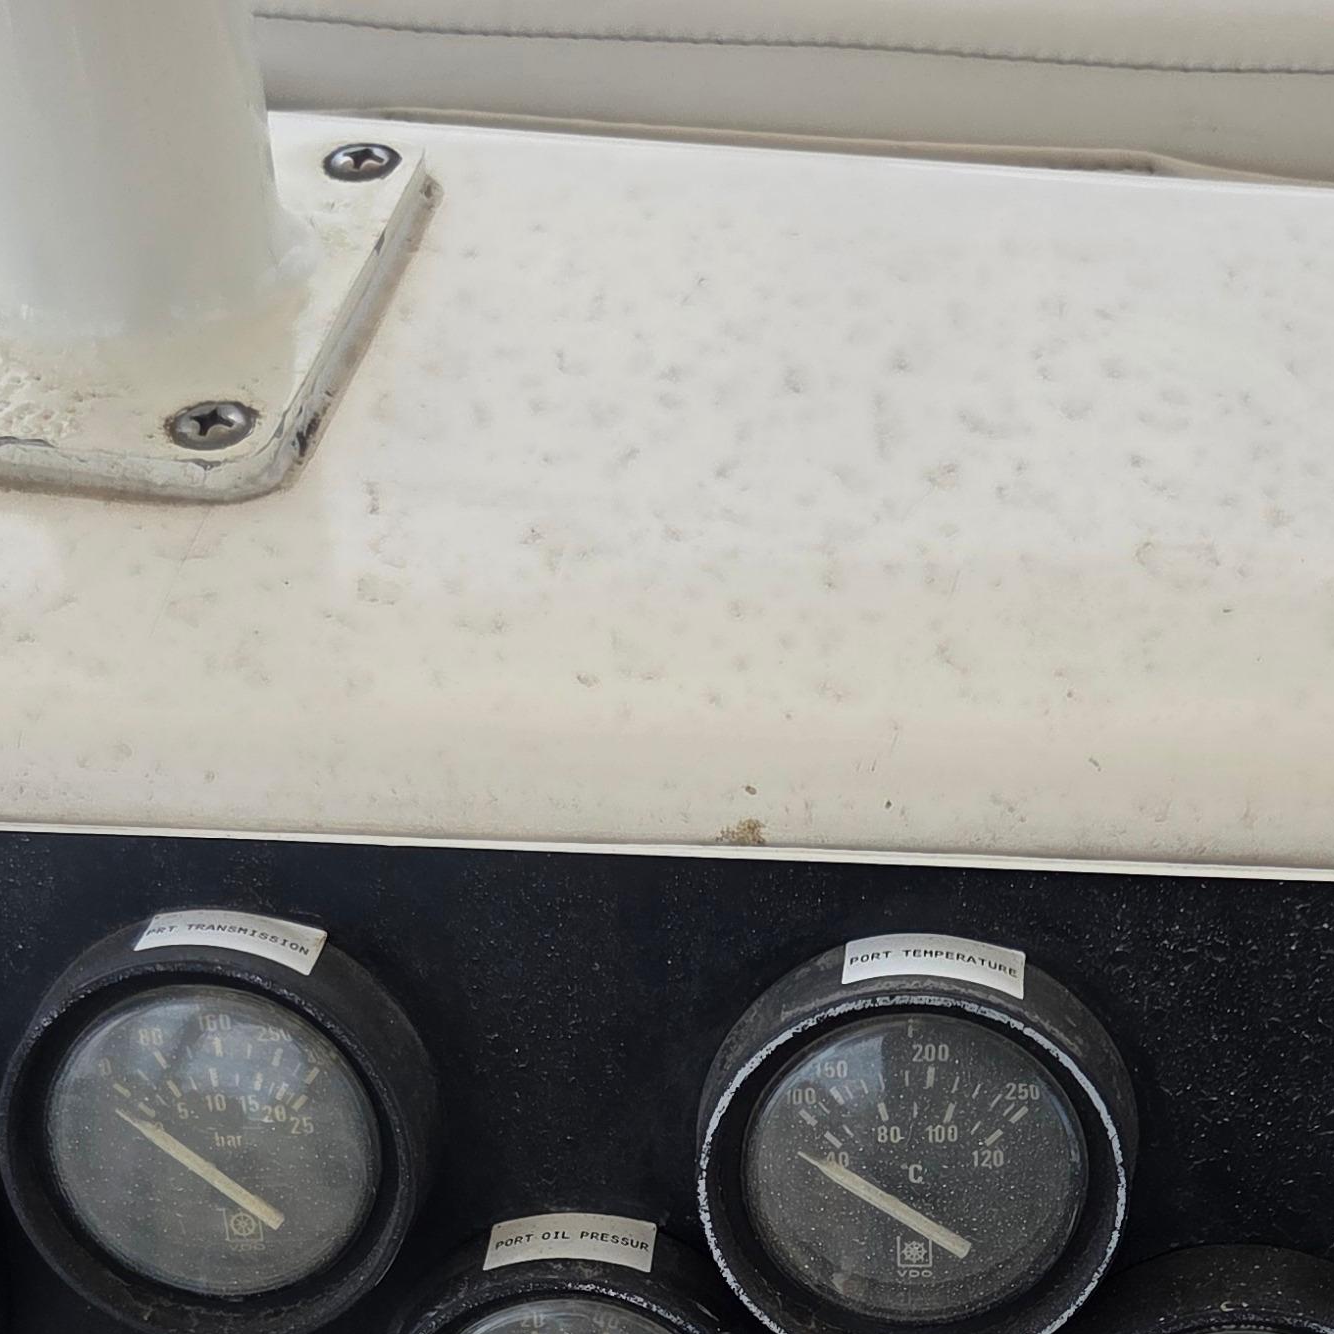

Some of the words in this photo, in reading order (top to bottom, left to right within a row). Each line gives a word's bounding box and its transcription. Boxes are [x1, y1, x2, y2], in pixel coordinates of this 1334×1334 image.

[145, 925, 177, 937] PRT
[186, 923, 310, 956] TRANSMISSION
[849, 951, 893, 966] PORT
[901, 949, 1019, 979] TEMPERATURE
[198, 1013, 232, 1032] 160
[912, 1043, 950, 1063] 200
[815, 1060, 849, 1079] 150
[788, 1087, 817, 1105] 100
[1004, 1082, 1040, 1100] 250
[177, 1101, 189, 1120] 5
[205, 1093, 227, 1112] 10
[240, 1094, 260, 1114] 15
[262, 1104, 287, 1123] 20
[290, 1116, 315, 1134] 25
[877, 1126, 901, 1143] 80
[926, 1125, 959, 1143] 100
[215, 1131, 242, 1148] bar
[971, 1150, 1005, 1168] 120
[495, 1233, 535, 1250] PORT
[541, 1230, 571, 1241] OIL
[579, 1230, 650, 1251] PRESSUR
[897, 1269, 934, 1278] VDO
